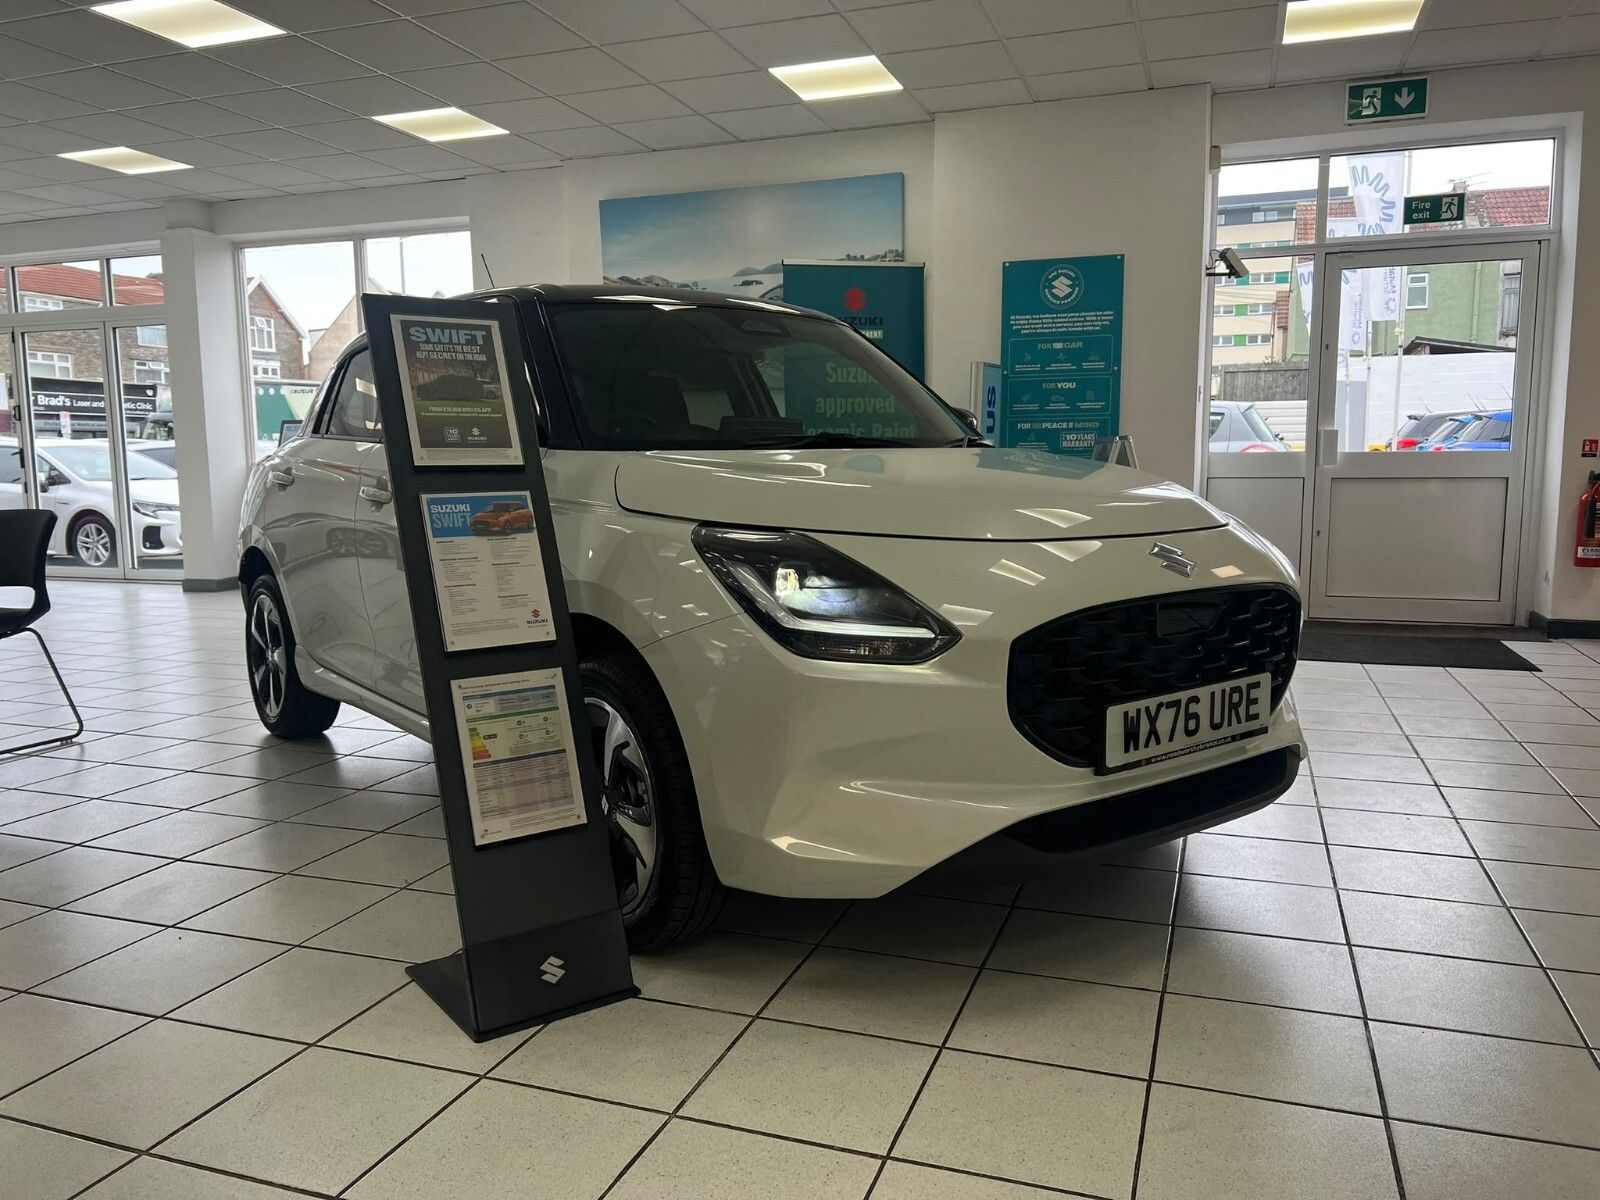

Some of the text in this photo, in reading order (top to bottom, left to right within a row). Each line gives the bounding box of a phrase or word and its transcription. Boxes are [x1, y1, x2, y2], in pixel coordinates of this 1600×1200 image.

[1412, 201, 1431, 209] Fire
[1412, 211, 1430, 220] exit
[408, 326, 487, 345] SWIFT
[463, 345, 481, 353] BEST
[1064, 341, 1084, 349] CAR
[429, 351, 457, 360] SECRET
[37, 394, 71, 406] Brad's
[72, 400, 90, 408] Laser
[91, 401, 105, 409] and
[136, 401, 153, 410] Clinic
[815, 394, 896, 418] approved
[986, 385, 997, 435] US
[1074, 421, 1100, 429] MIND
[1065, 433, 1077, 441] 10
[1077, 432, 1096, 440] YEARS
[1062, 440, 1095, 448] WARRANTY
[430, 504, 471, 514] SUZUKI
[433, 513, 472, 529] SWIFT
[526, 618, 549, 626] SUZUKI
[1123, 679, 1262, 755] WX76 URE
